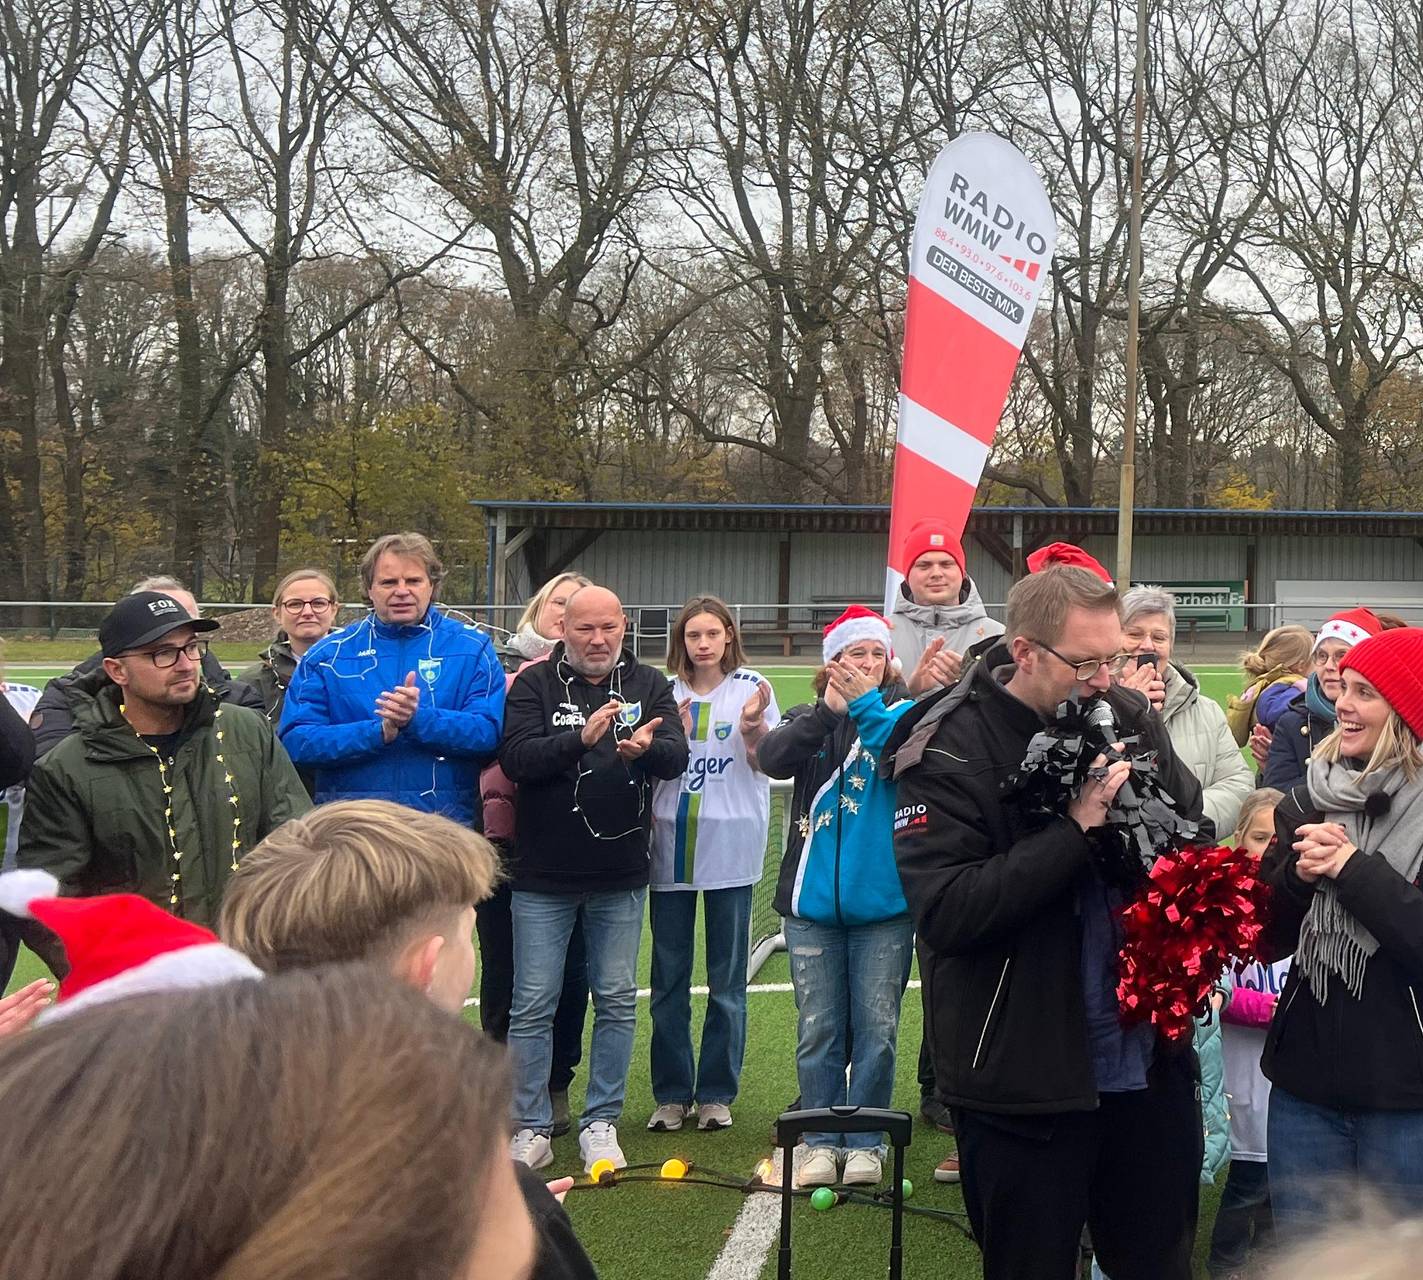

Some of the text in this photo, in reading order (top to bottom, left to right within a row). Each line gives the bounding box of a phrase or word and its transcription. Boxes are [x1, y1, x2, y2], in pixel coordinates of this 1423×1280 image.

[943, 197, 1002, 252] WMW
[949, 172, 1047, 255] RADIO
[933, 251, 1018, 321] DER BESTE MIX.
[960, 244, 980, 263] 93.0
[985, 262, 1003, 281] 97.6
[1008, 279, 1032, 301] 103.6
[147, 600, 176, 611] FOX
[552, 712, 586, 726] Coach
